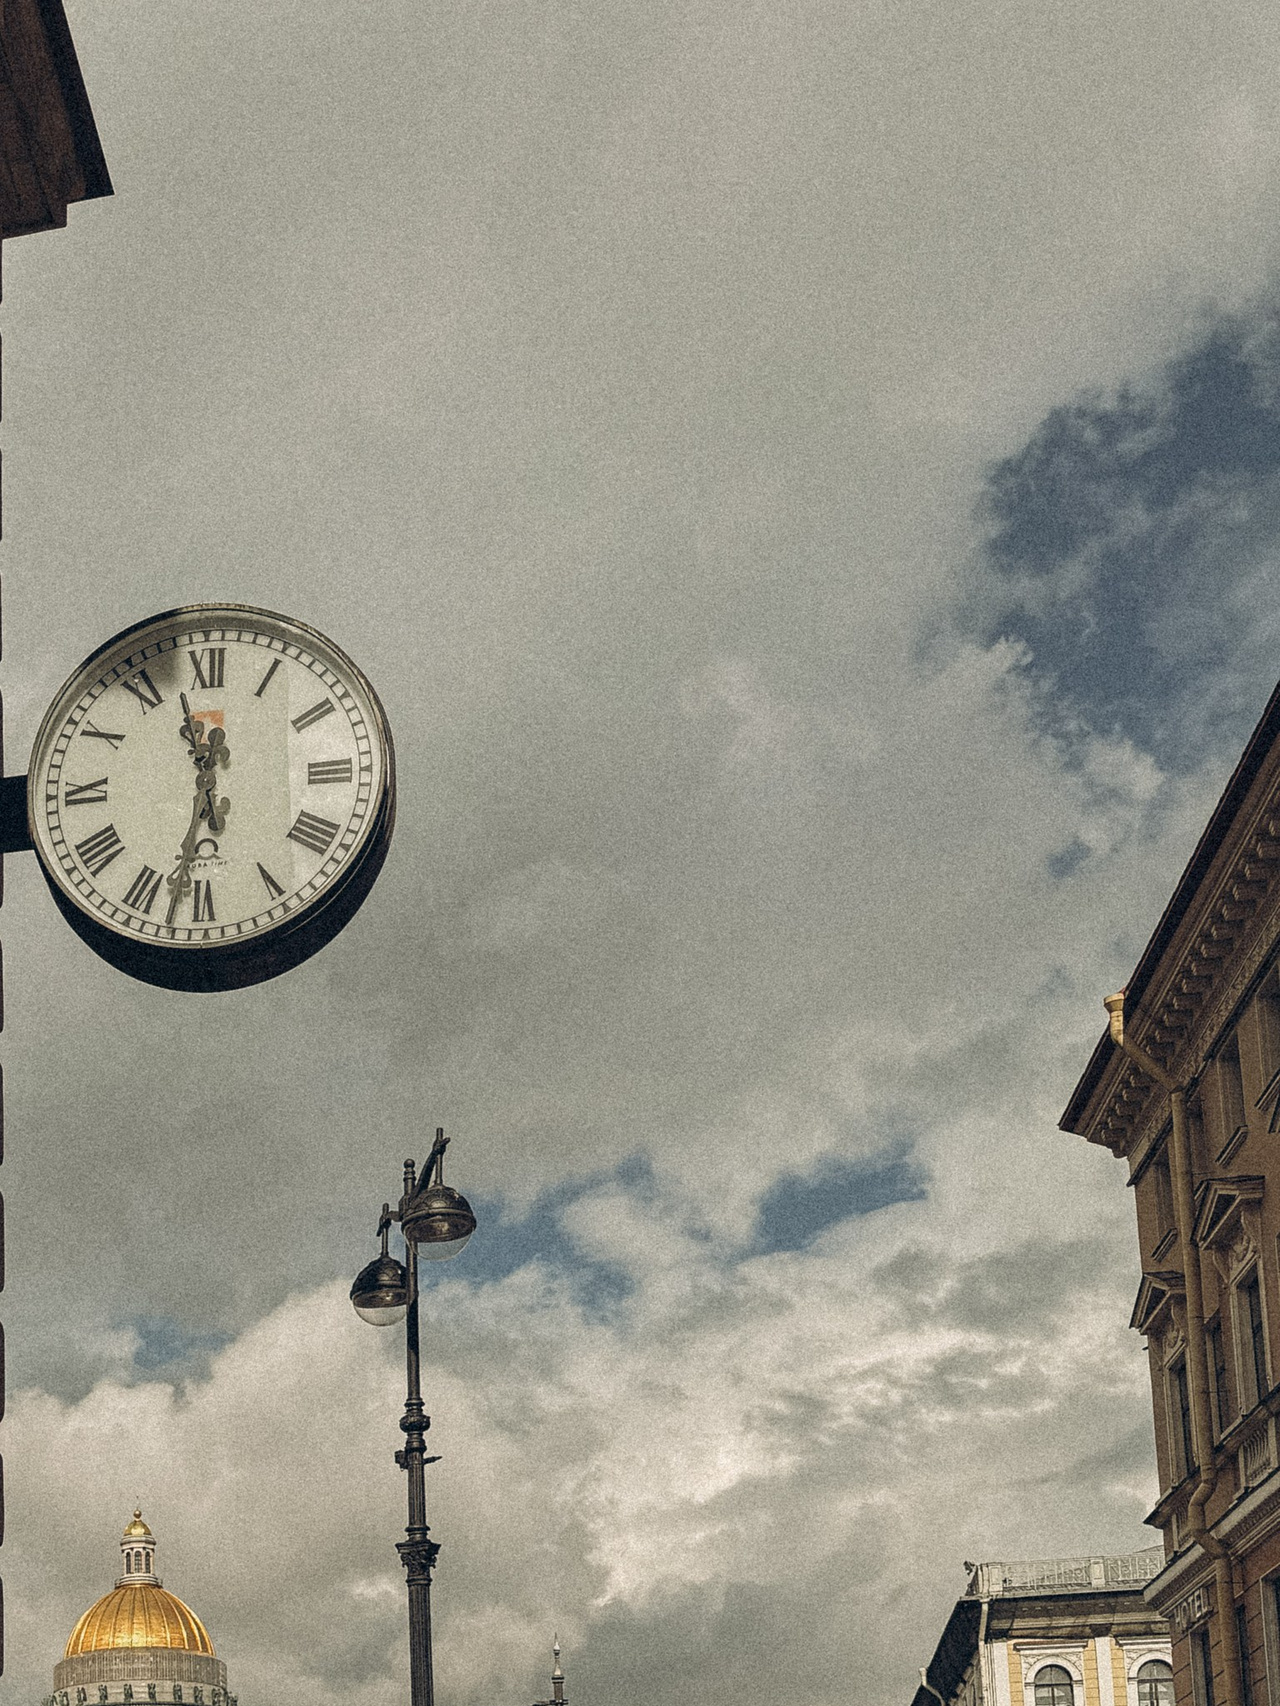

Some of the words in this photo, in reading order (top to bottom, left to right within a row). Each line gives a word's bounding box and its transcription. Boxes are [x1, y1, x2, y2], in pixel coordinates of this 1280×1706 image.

[188, 648, 227, 690] XII
[120, 667, 166, 715] XI
[80, 720, 126, 750] X
[291, 697, 336, 733] II
[64, 776, 109, 807] IX
[307, 758, 352, 785] III
[74, 823, 126, 878] VIII
[121, 865, 164, 915] VII
[256, 862, 286, 900] V
[1173, 1587, 1210, 1630] HOTEL
